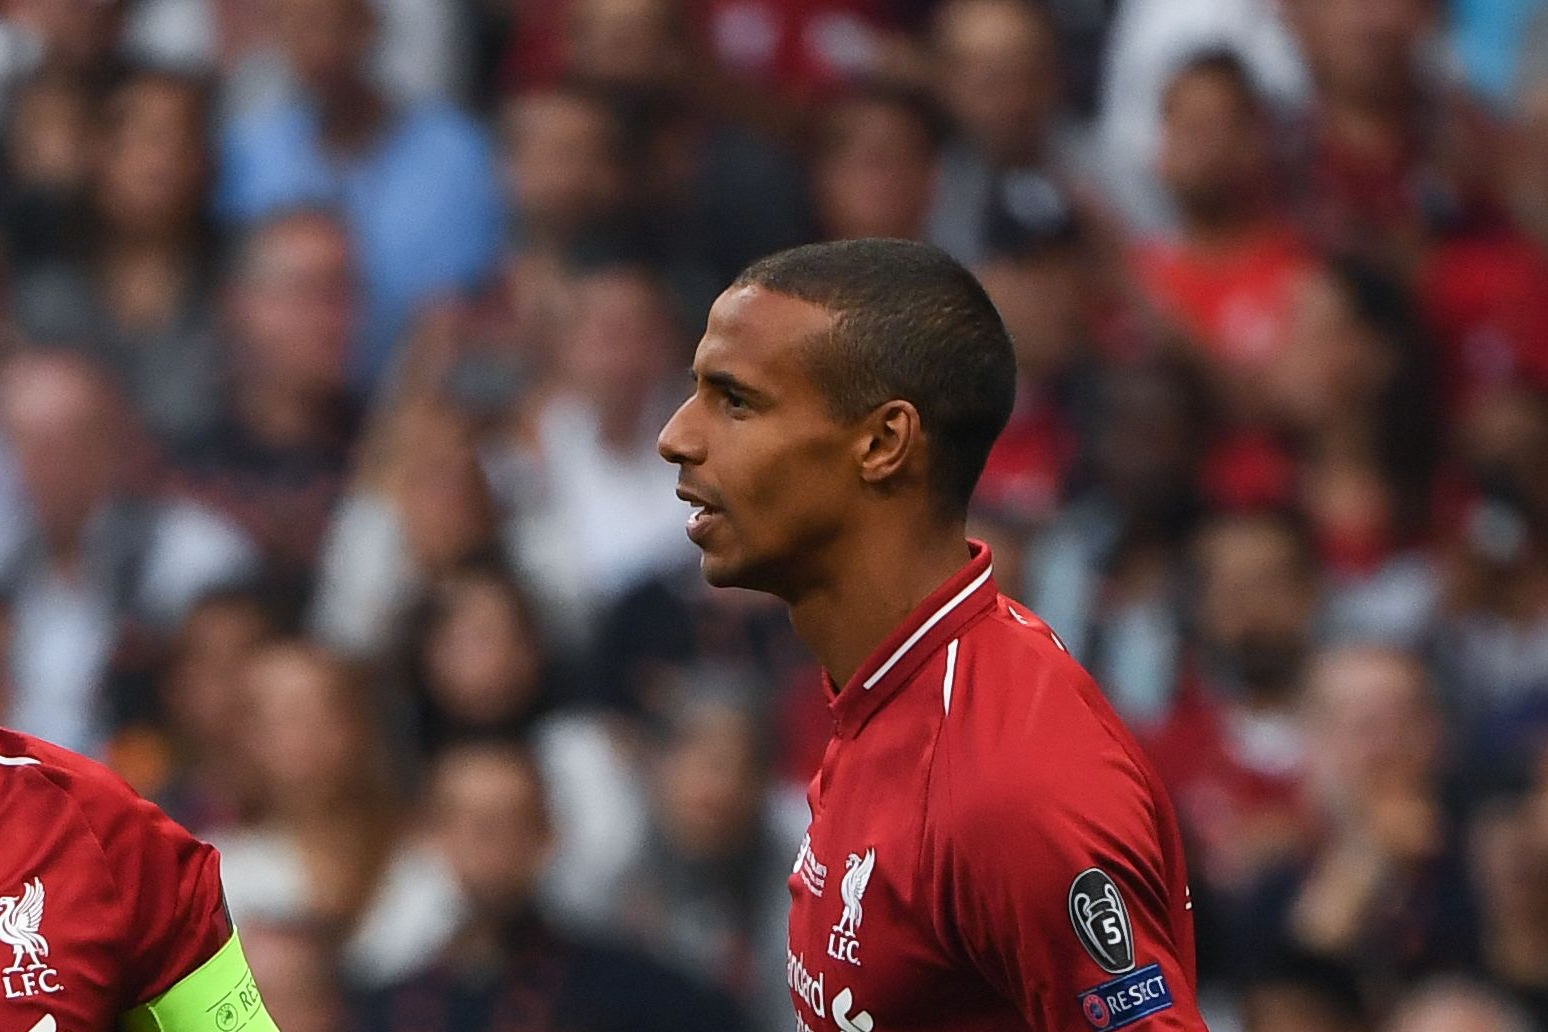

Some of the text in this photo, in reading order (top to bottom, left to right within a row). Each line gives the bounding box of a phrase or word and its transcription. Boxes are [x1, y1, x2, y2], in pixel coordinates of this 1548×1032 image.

[1102, 916, 1122, 945] 5
[2, 968, 65, 999] L.F.C.
[1106, 975, 1166, 1015] RESECT
